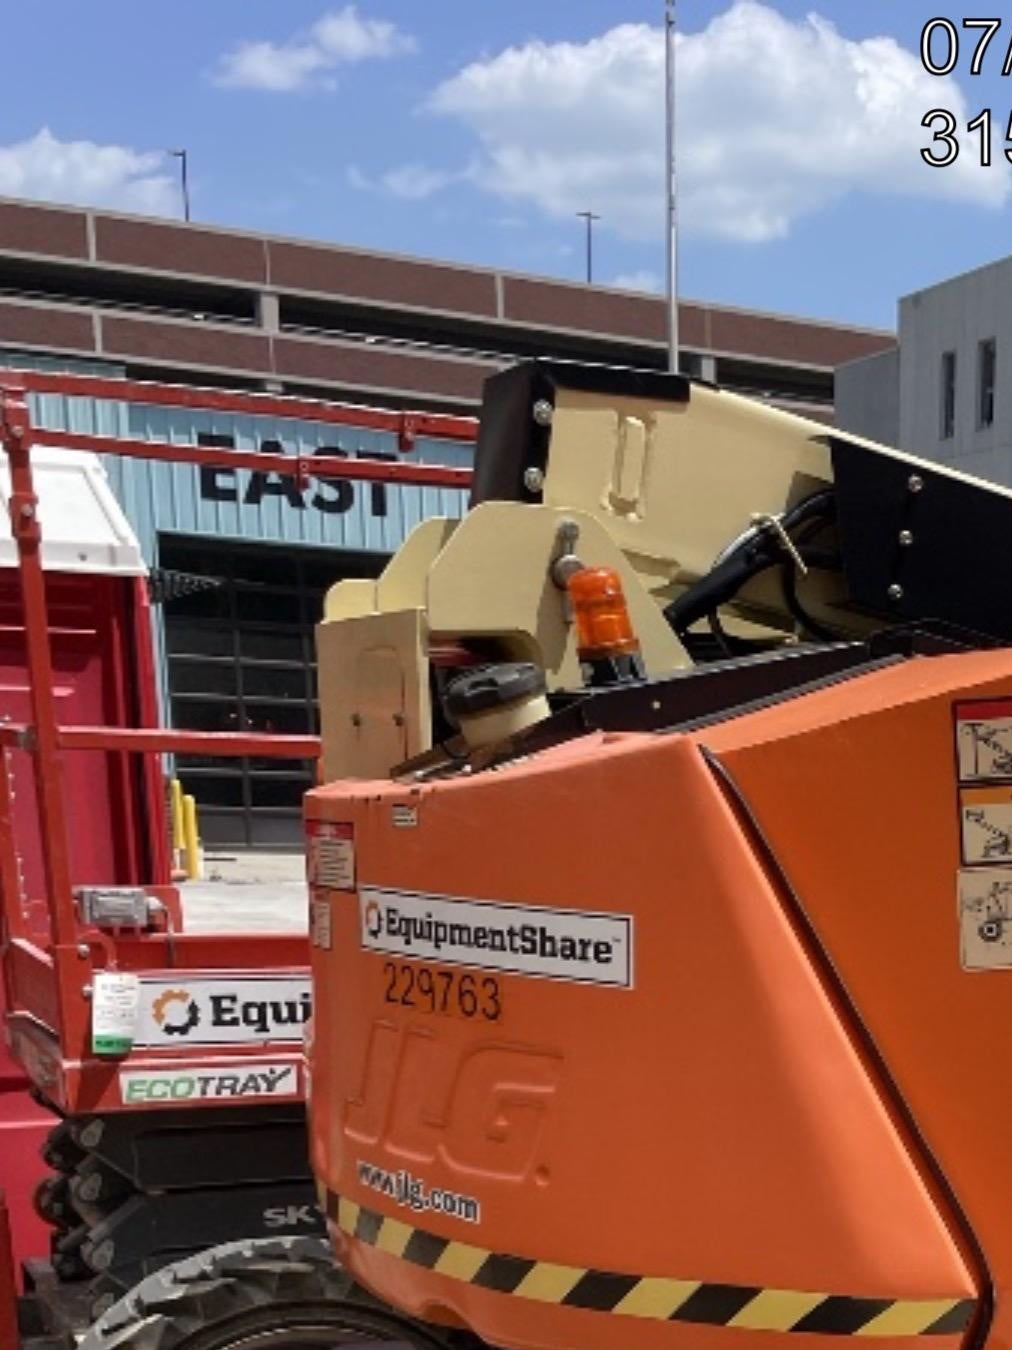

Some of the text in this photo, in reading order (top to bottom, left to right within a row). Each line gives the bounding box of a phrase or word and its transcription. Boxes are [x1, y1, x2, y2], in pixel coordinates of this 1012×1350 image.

[197, 432, 398, 517] EAST
[385, 908, 613, 964] EquipmentShare
[209, 992, 313, 1033] Equi
[384, 962, 501, 1021] 229763
[126, 1067, 292, 1101] ECOTRAY
[263, 1204, 324, 1228] SK
